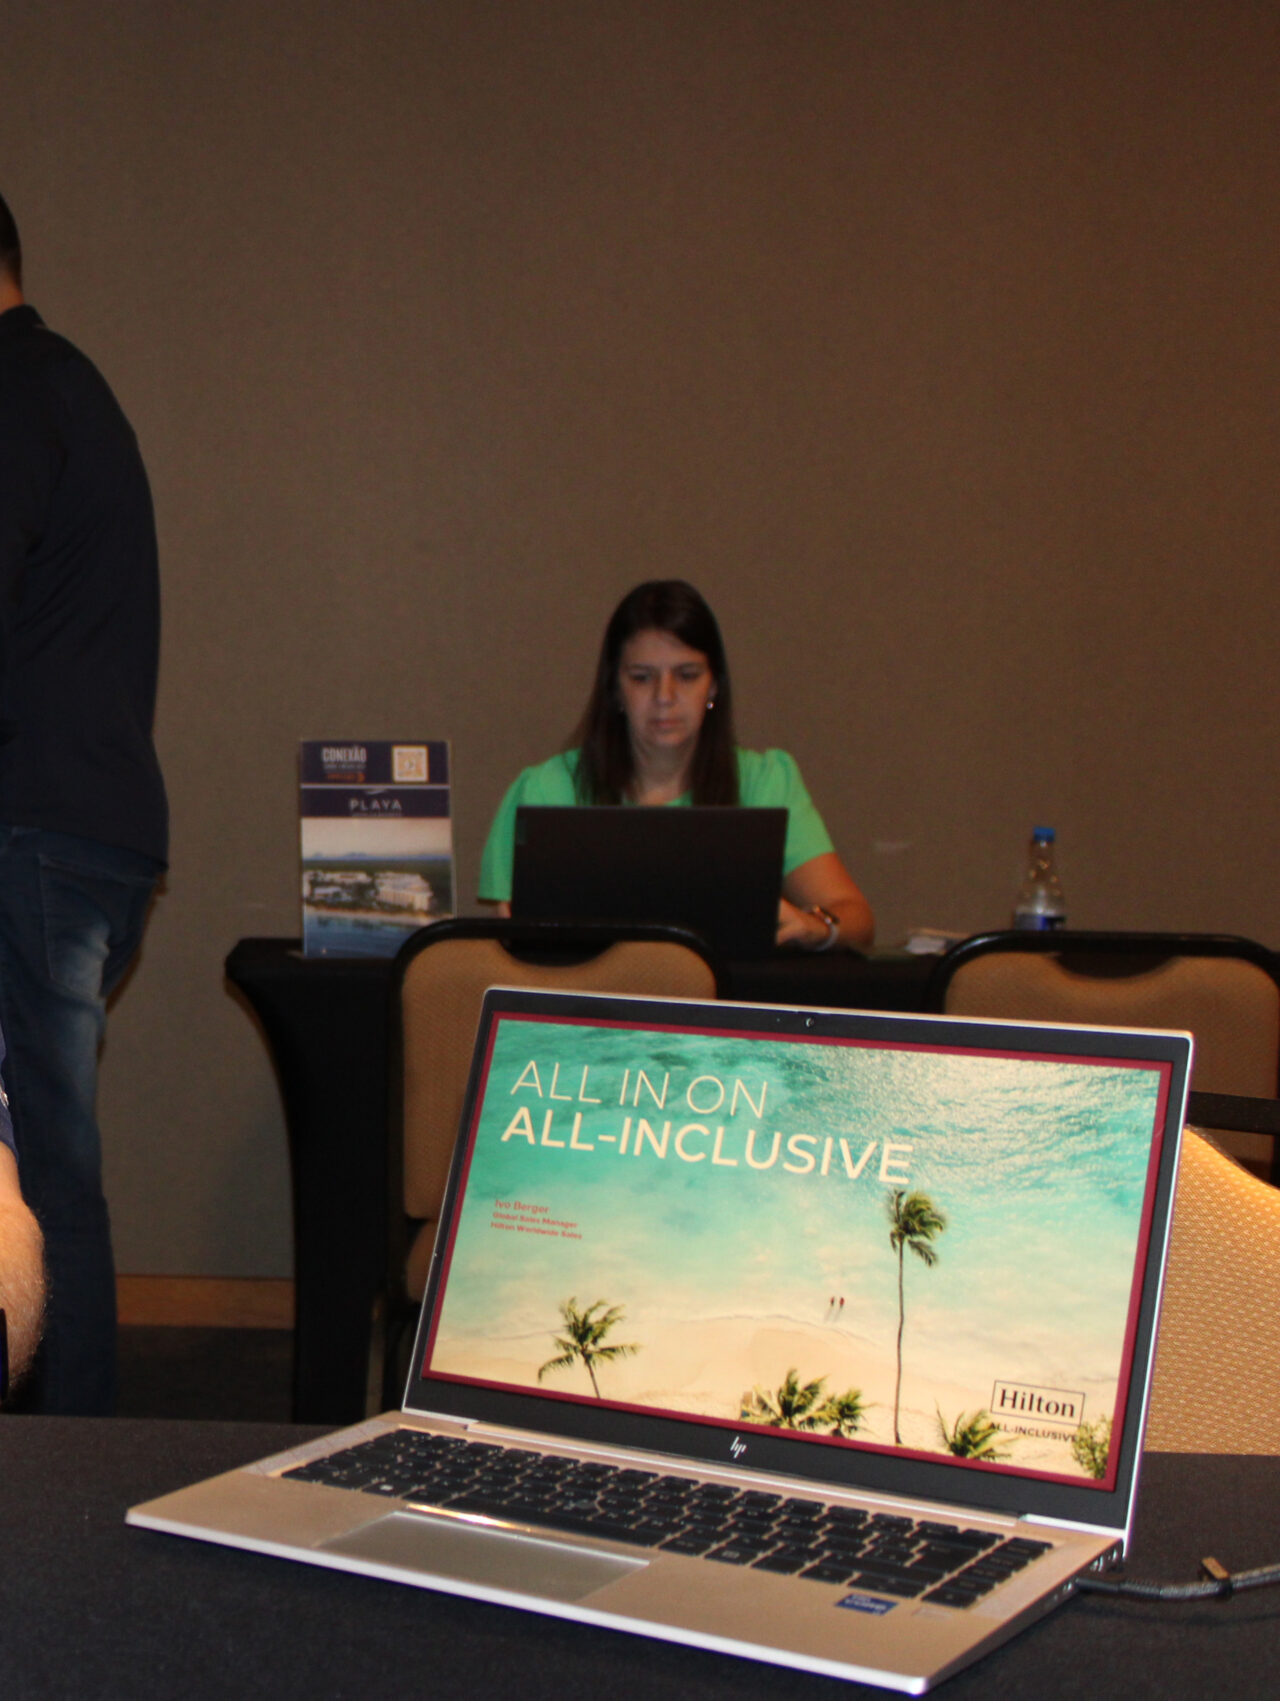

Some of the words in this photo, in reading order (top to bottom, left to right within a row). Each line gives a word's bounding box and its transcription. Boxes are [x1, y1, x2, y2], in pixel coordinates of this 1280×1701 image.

[322, 745, 367, 763] CONEXÃO
[349, 798, 402, 811] PLAYA
[510, 1060, 601, 1104] ALL
[619, 1068, 670, 1110] IN
[686, 1075, 769, 1119] ON
[500, 1106, 915, 1186] ALL-INCLUSIVE
[495, 1200, 511, 1210] Ivo
[513, 1201, 550, 1214] Berger
[1000, 1388, 1075, 1419] Hilton
[988, 1421, 1078, 1443] ALL-INCLUSIVE
[730, 1435, 747, 1459] hp
